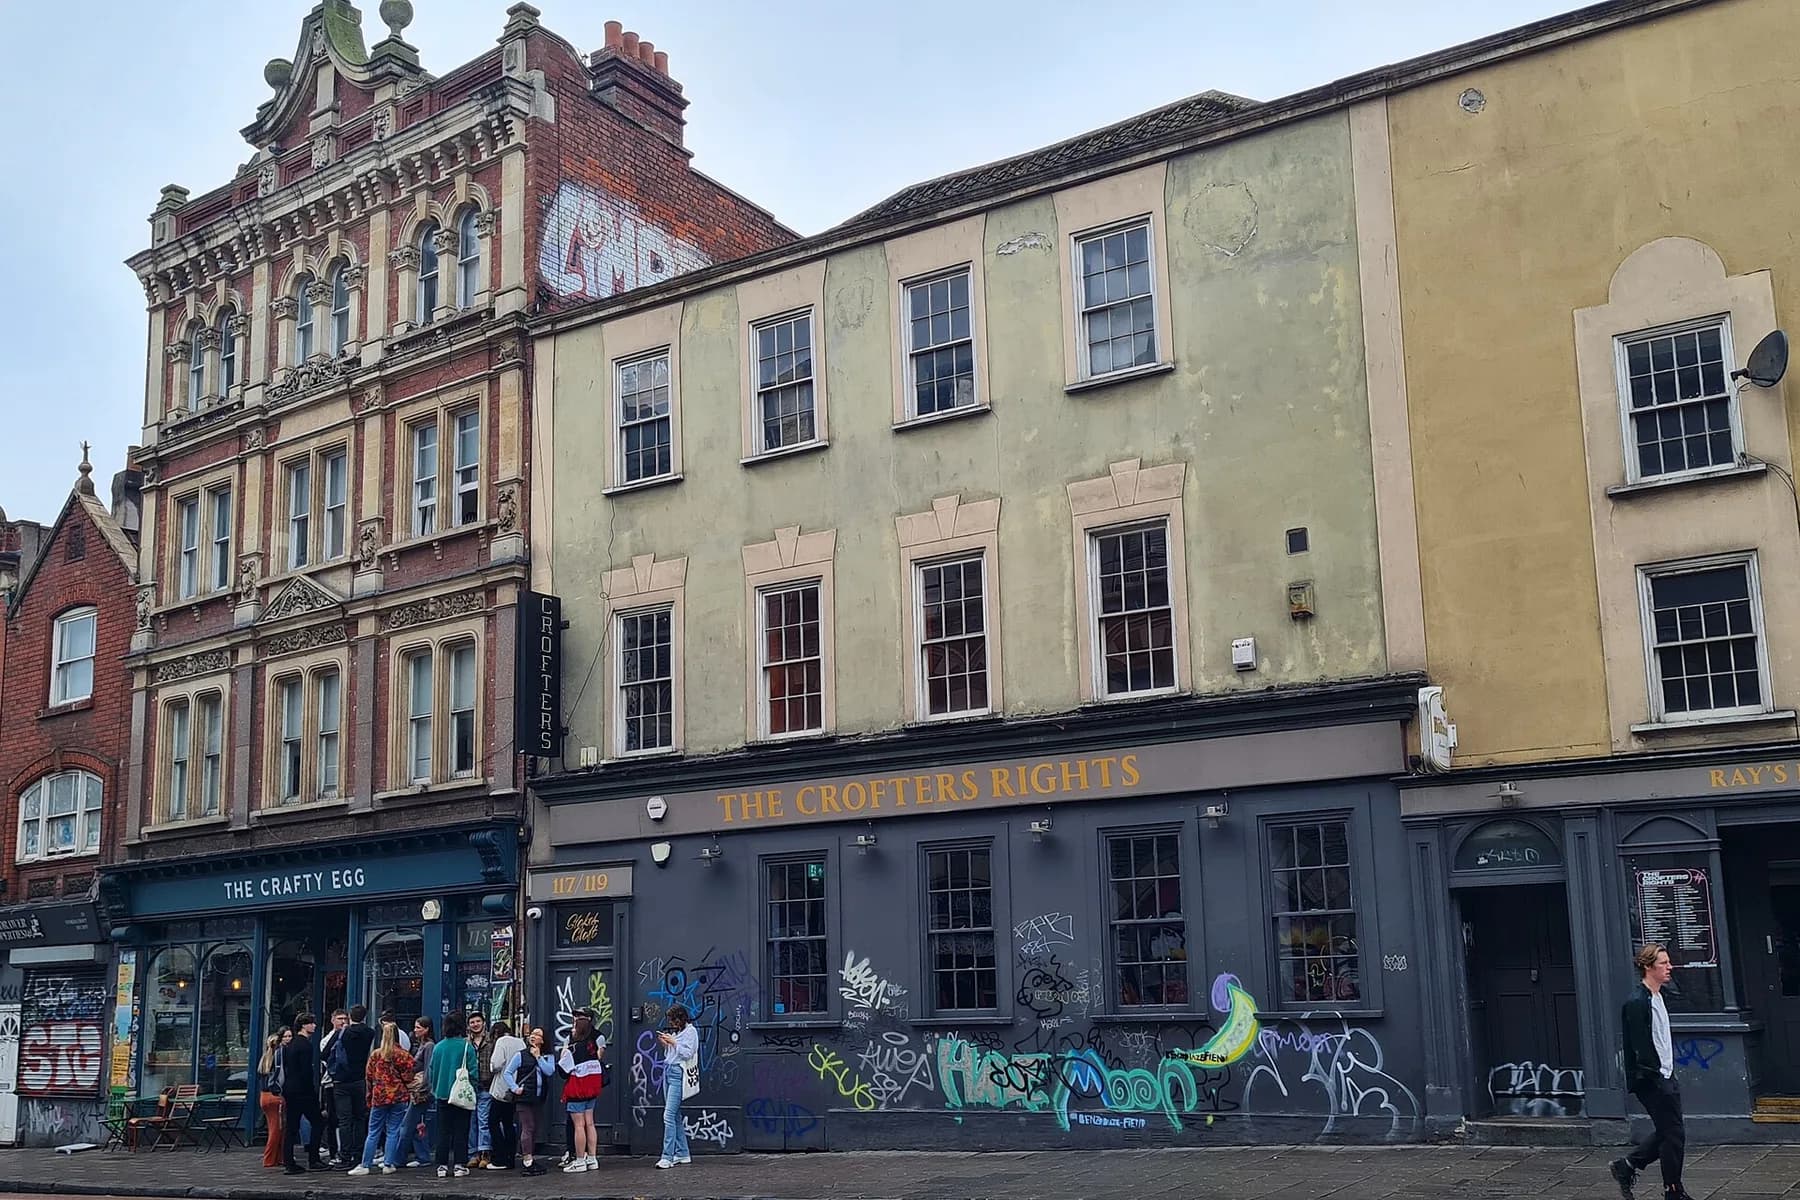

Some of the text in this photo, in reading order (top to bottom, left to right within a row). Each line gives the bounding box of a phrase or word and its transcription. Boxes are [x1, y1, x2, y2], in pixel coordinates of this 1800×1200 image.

[541, 597, 552, 750] CROFTERS
[716, 754, 1141, 822] THE CROFTERS RIGHTS
[1709, 763, 1788, 788] RAY'S
[224, 868, 365, 899] THE CRAFTY EGG
[552, 873, 608, 894] 117/119
